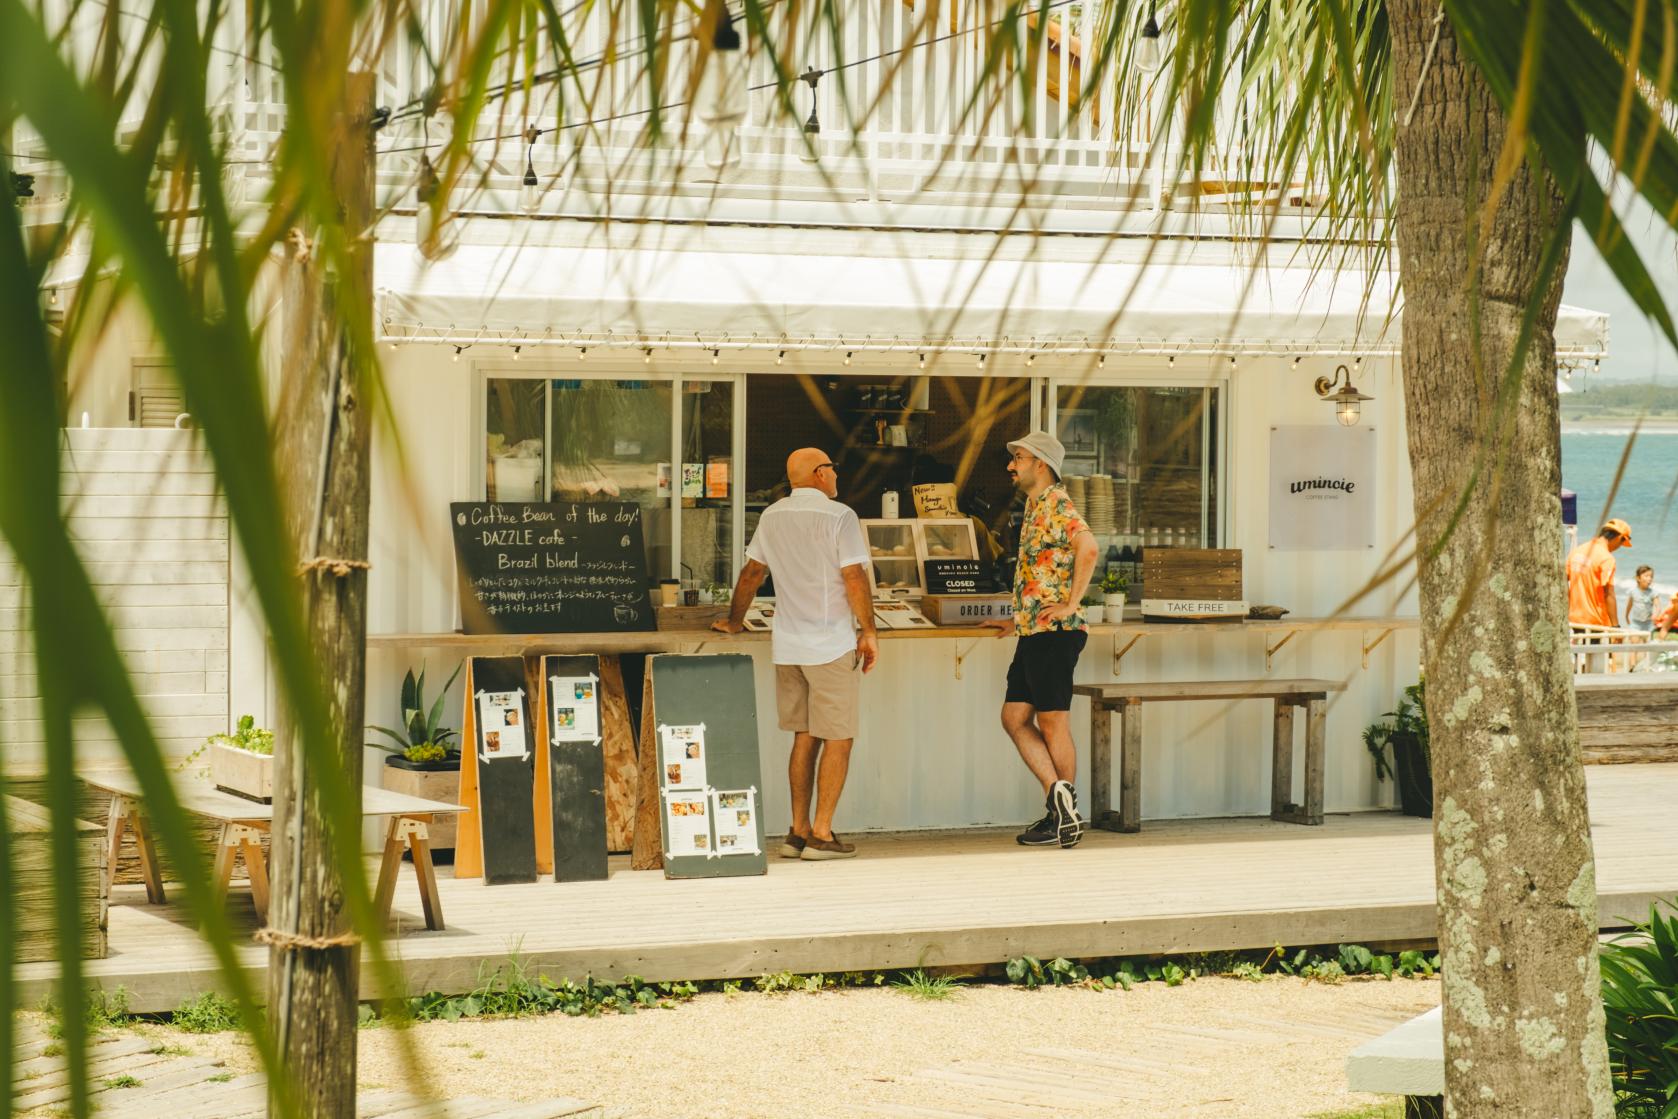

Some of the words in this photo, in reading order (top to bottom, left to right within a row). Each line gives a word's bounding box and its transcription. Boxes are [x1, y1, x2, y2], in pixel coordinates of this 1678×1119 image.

[1290, 476, 1355, 494] uminoie
[471, 504, 518, 526] Coffee
[522, 506, 556, 524] Bean
[566, 504, 578, 523] of
[587, 506, 608, 524] the
[615, 505, 640, 527] day!
[539, 528, 566, 546] cafe
[498, 552, 538, 569] Brazil
[546, 551, 579, 569] blend
[946, 580, 976, 588] CLOSED
[960, 605, 993, 616] ORDER
[1000, 604, 1013, 616] HE
[1168, 603, 1194, 612] TAKE
[1198, 603, 1224, 612] FREE
